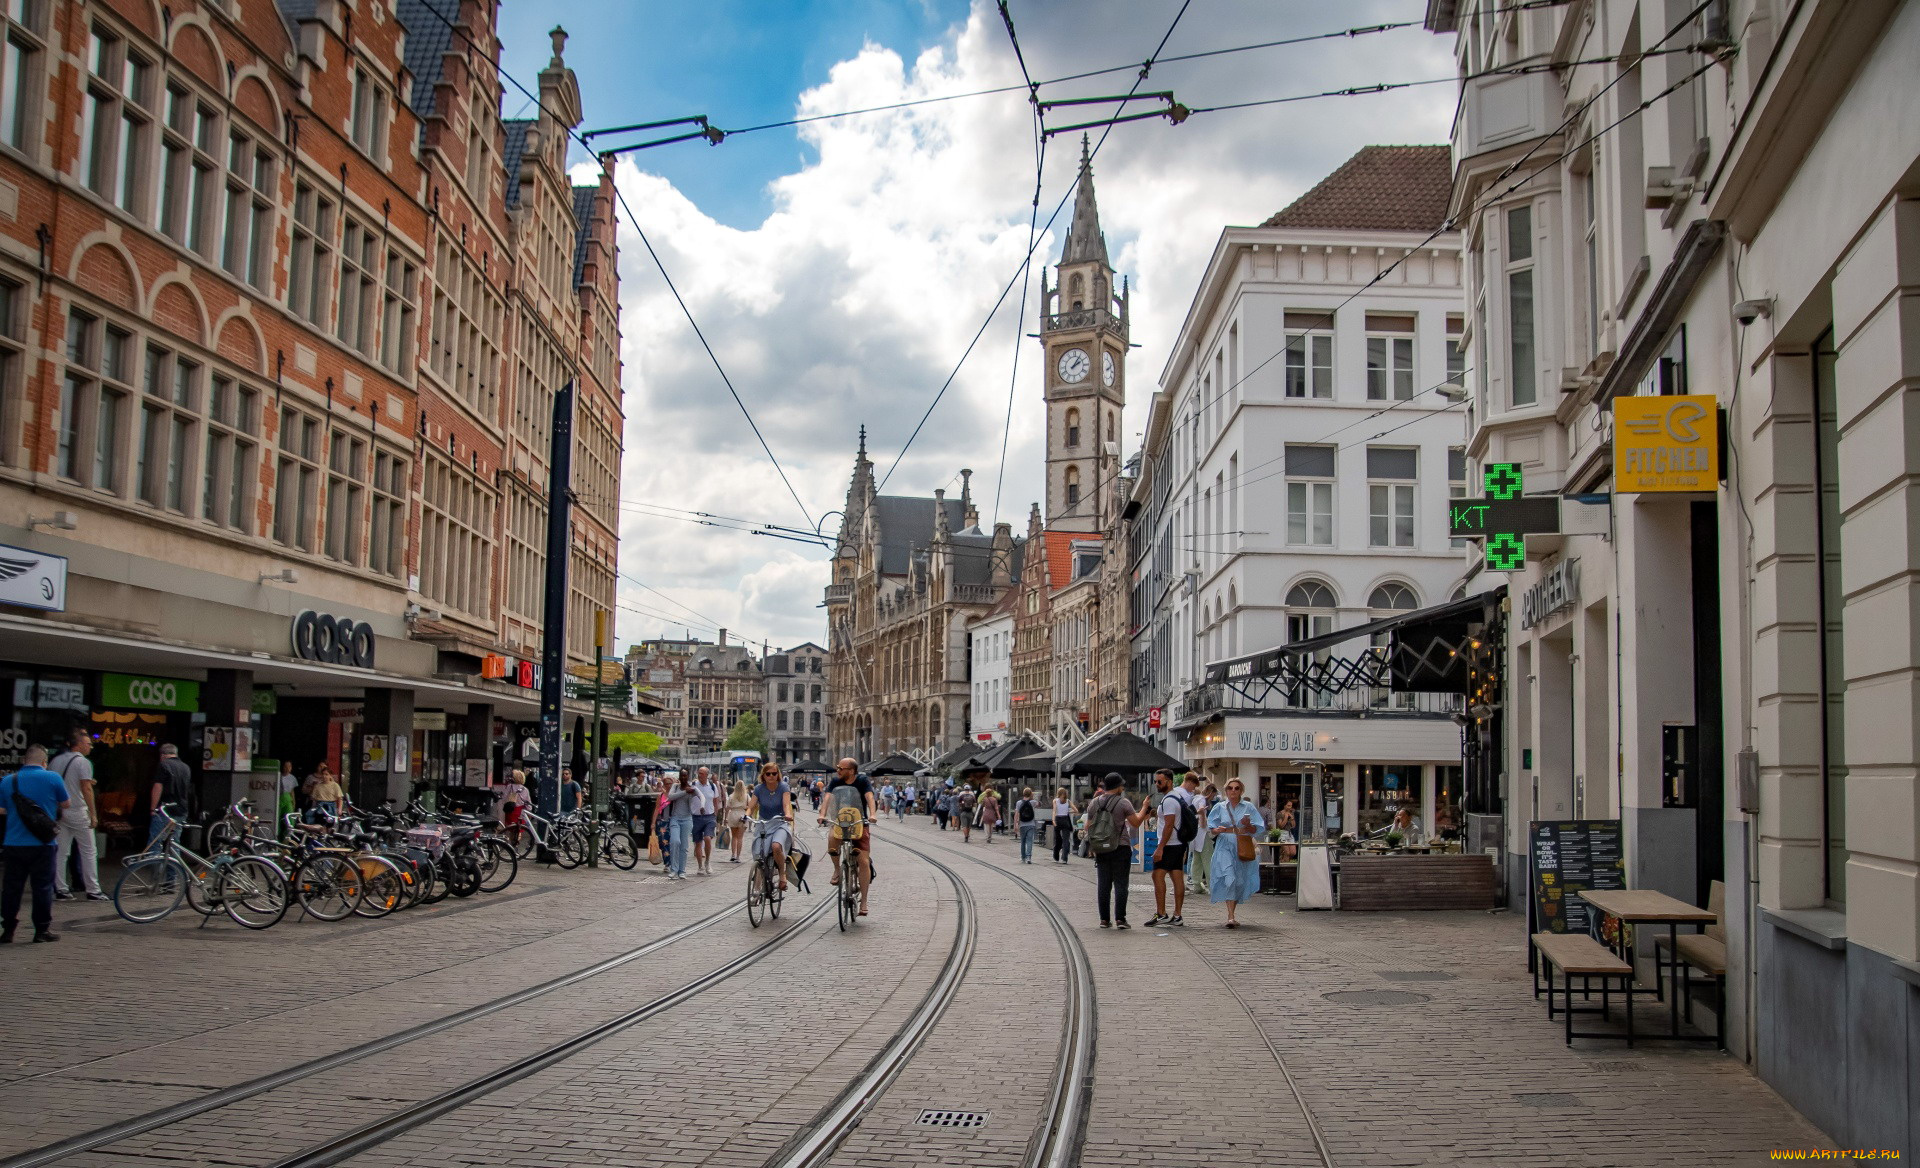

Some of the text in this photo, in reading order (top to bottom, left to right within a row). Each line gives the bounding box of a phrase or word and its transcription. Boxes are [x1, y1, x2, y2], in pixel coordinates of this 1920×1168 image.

[1450, 506, 1490, 529] KT
[129, 680, 176, 706] casa
[1239, 731, 1315, 751] WASBAR
